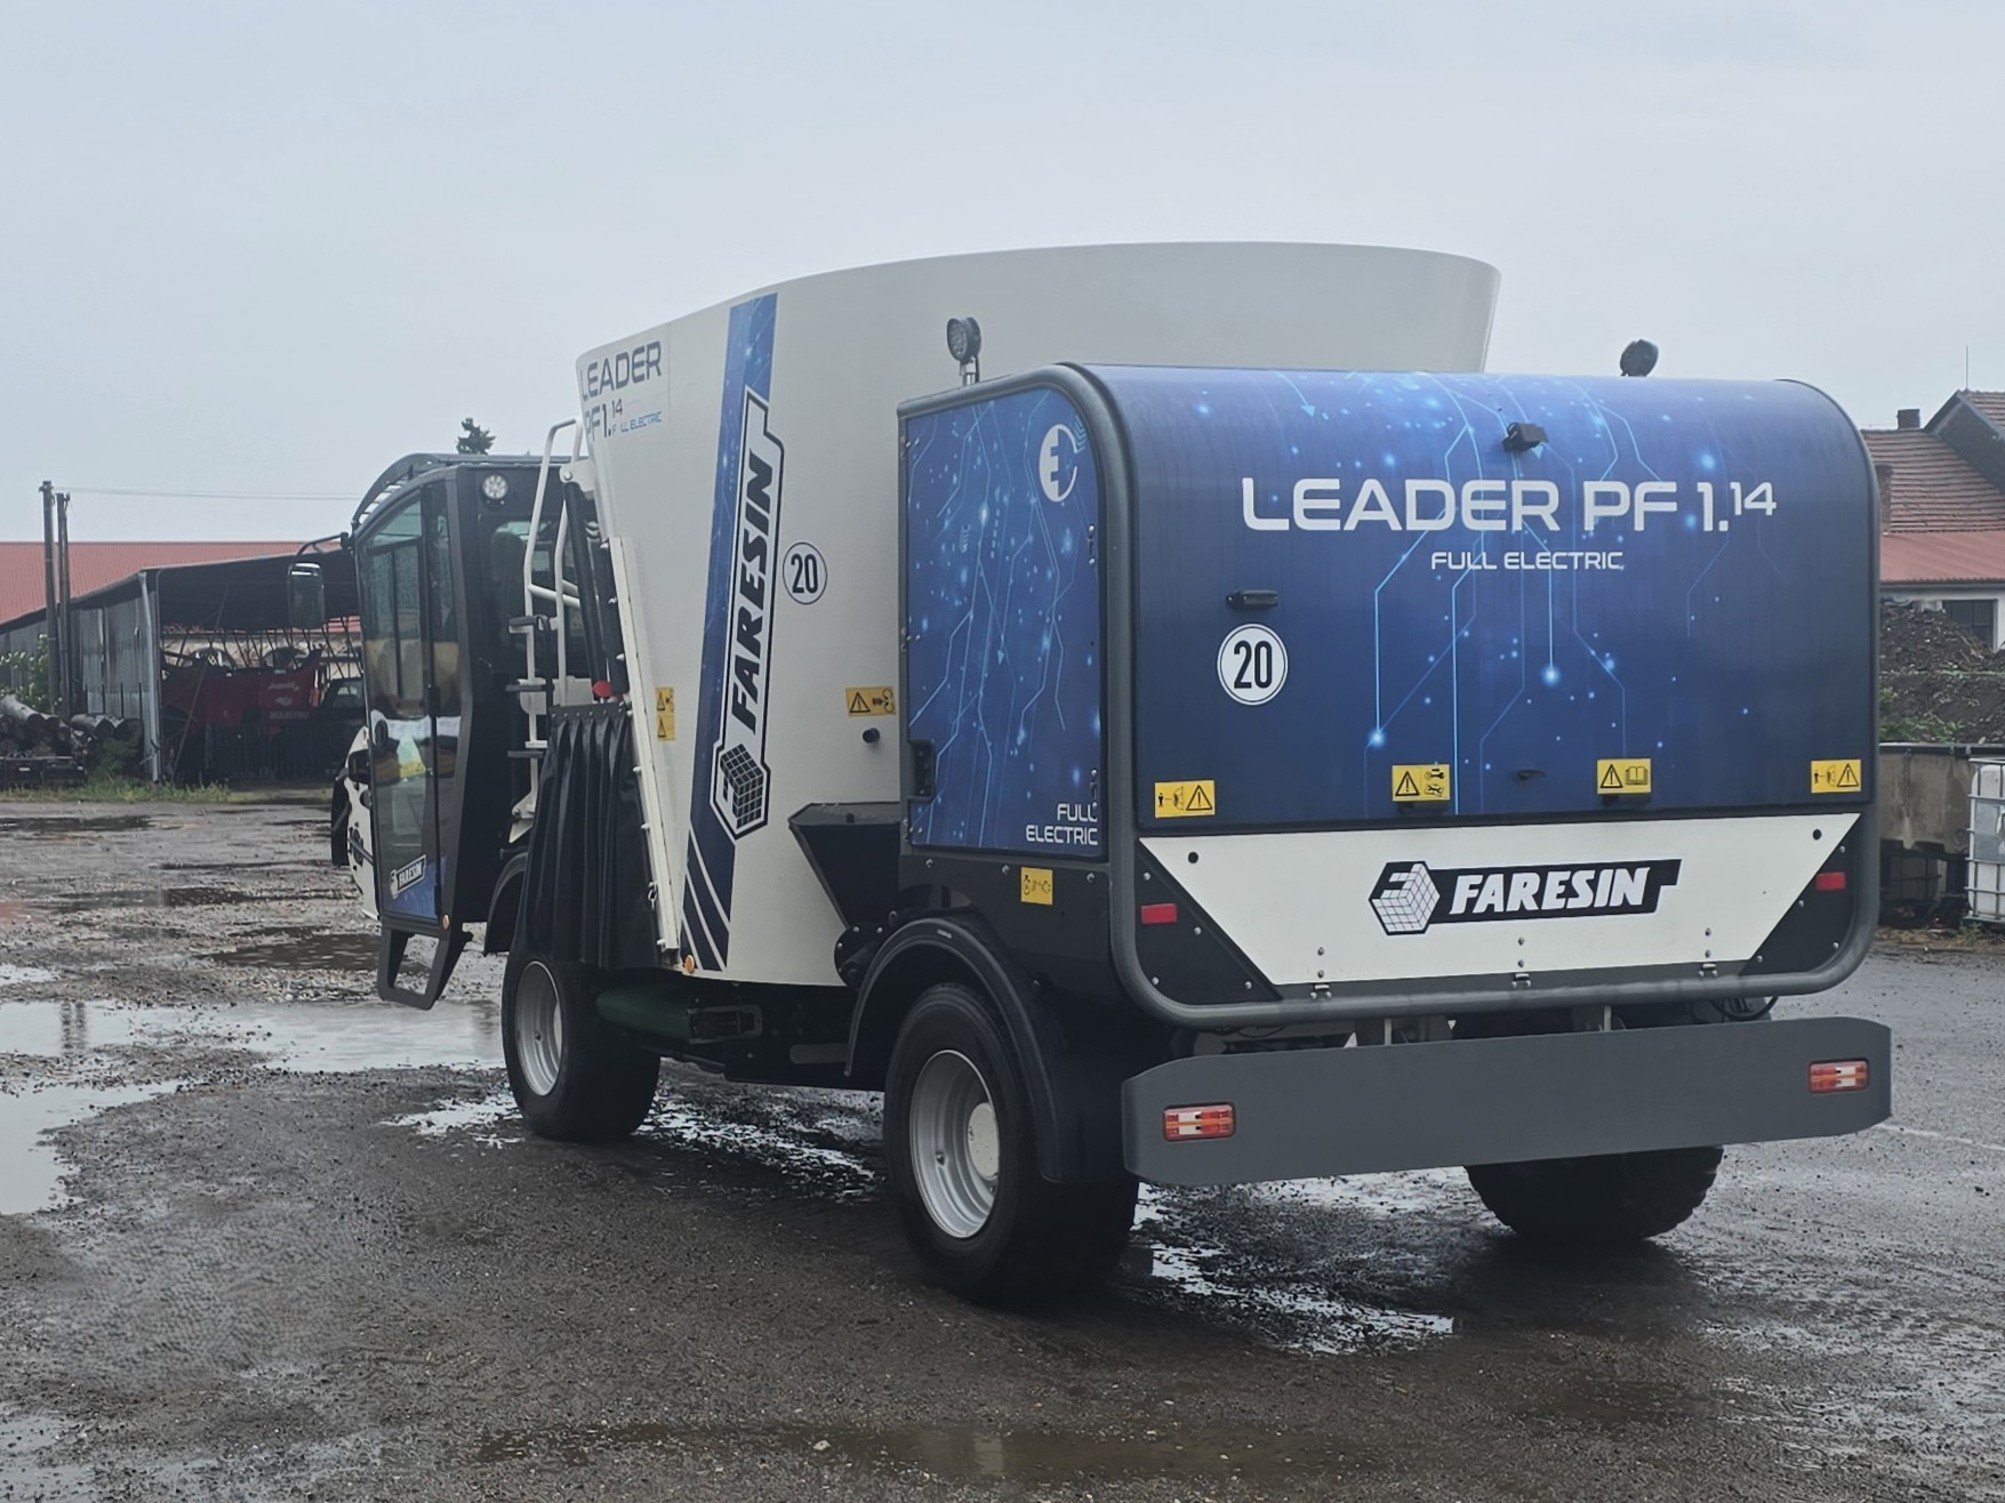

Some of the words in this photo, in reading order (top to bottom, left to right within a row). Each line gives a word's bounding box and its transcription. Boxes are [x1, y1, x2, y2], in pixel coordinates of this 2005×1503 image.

[579, 341, 662, 402] LEADER
[1242, 477, 1561, 531] LEADER
[1583, 480, 1677, 532] PF
[791, 553, 819, 594] 20
[1431, 551, 1498, 570] FULL
[1504, 551, 1624, 571] ELECTRIC
[731, 449, 773, 735] FARESIN
[1233, 640, 1273, 689] 20
[1025, 824, 1099, 846] ELECTRIC
[1057, 803, 1098, 823] FULL
[1448, 866, 1652, 916] FARESIN
